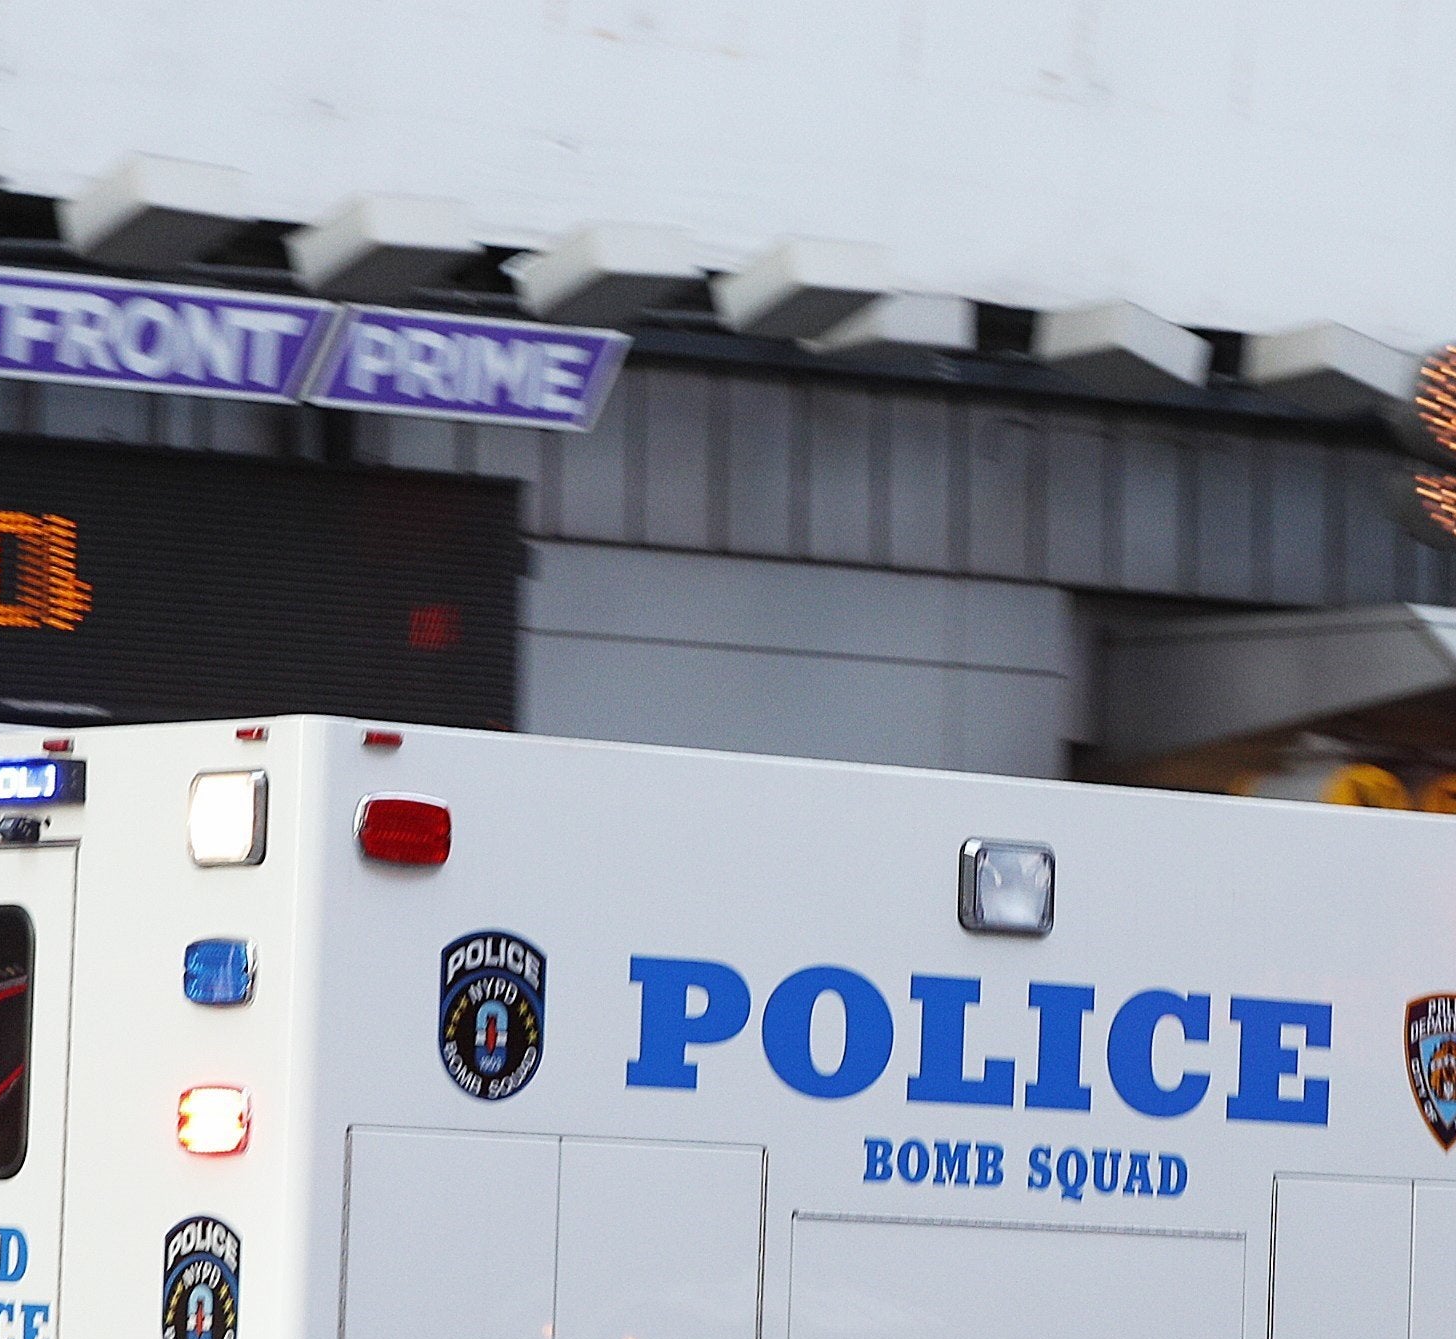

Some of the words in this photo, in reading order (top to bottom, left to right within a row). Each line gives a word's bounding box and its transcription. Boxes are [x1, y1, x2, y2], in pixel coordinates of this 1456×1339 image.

[347, 320, 594, 416] PRIME
[446, 936, 541, 991] POLICE
[468, 976, 518, 1006] NYPD
[625, 953, 1334, 1128] POLICE
[862, 1137, 1005, 1187] BOMB
[1027, 1144, 1190, 1201] SQUAD
[166, 1220, 239, 1273] POLICE
